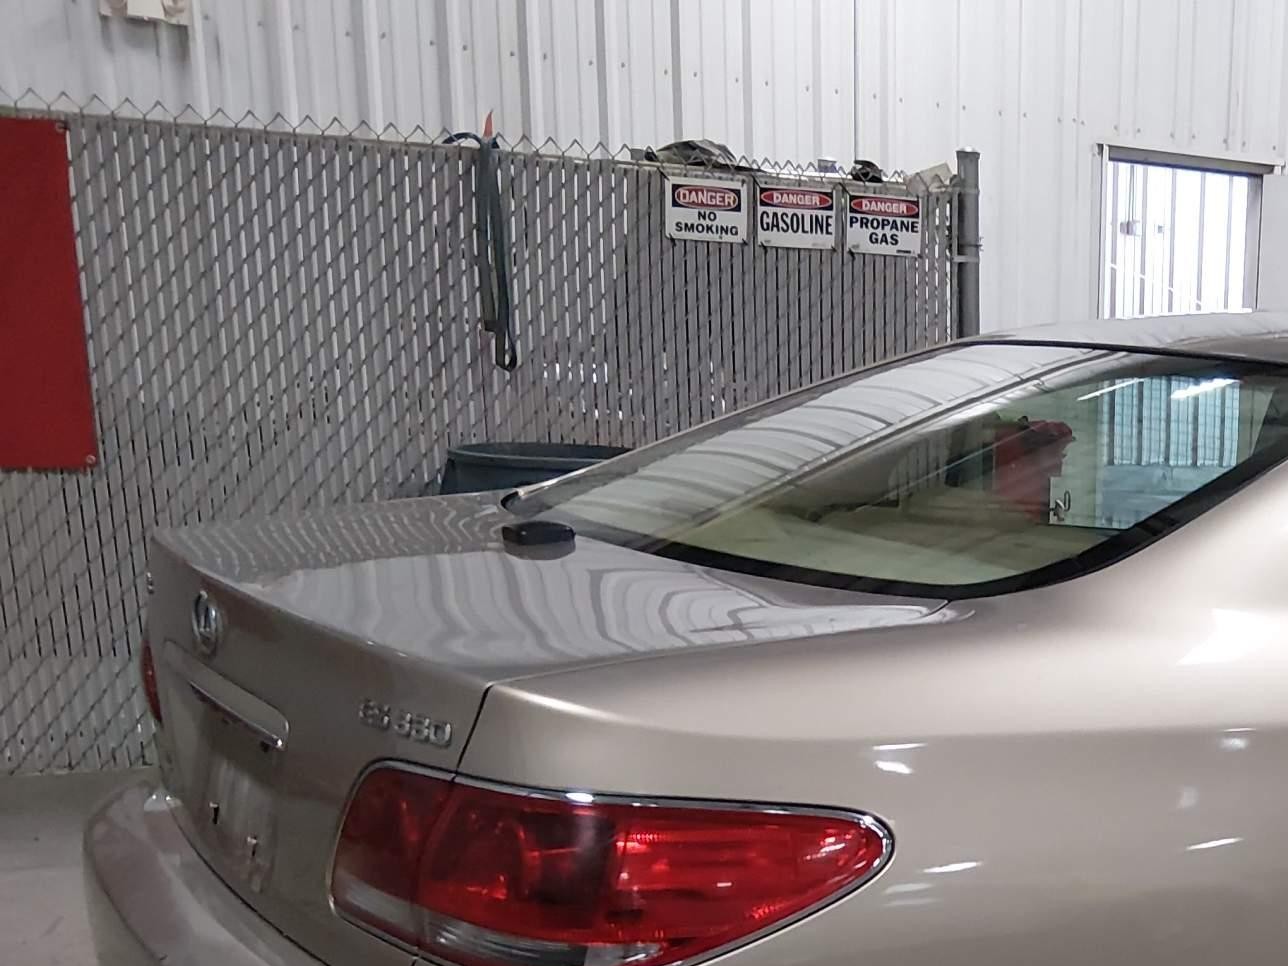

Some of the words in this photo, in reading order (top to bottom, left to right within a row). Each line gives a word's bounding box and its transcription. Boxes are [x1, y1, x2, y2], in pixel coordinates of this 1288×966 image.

[680, 189, 734, 206] DANGER
[773, 192, 820, 206] DANGER
[862, 199, 907, 214] DANGER
[697, 211, 717, 222] NO
[760, 211, 833, 235] GASOLINE
[675, 221, 739, 236] SMOKING
[849, 216, 919, 233] PROPANE
[869, 232, 899, 246] GAS
